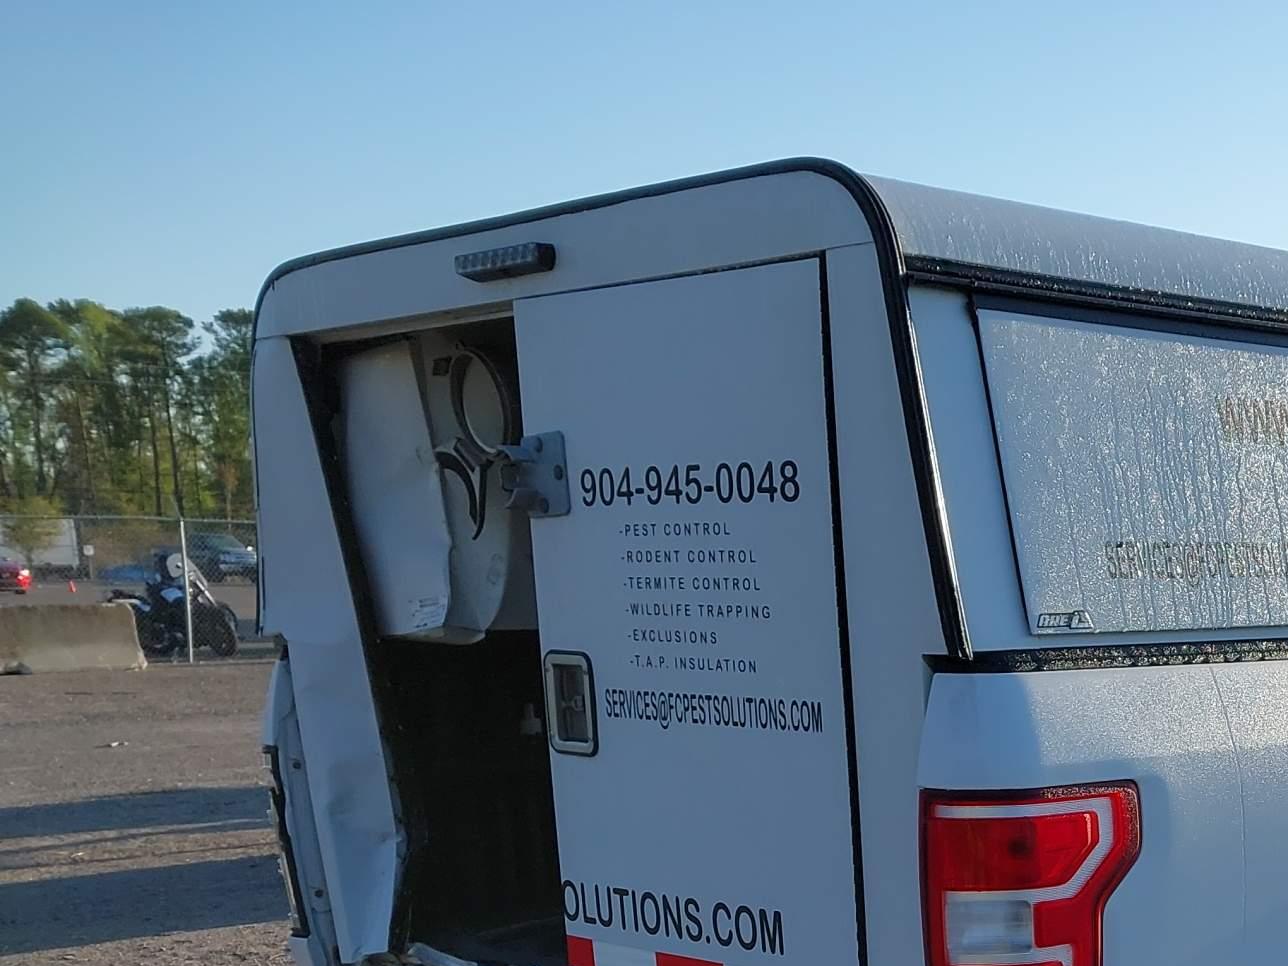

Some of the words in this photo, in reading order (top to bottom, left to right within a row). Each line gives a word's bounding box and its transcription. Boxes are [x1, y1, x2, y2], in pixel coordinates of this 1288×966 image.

[580, 460, 800, 507] 904-945-0048
[663, 522, 731, 536] CONTROL
[687, 550, 757, 563] CONTROL
[692, 577, 761, 591] CONTROL
[699, 604, 771, 619] TRAPPING
[674, 656, 758, 673] INSULATION
[604, 688, 824, 733] SERVICES@FCPESTSOLUTIONS.COM
[562, 879, 785, 956] OLUTIONS.COM
